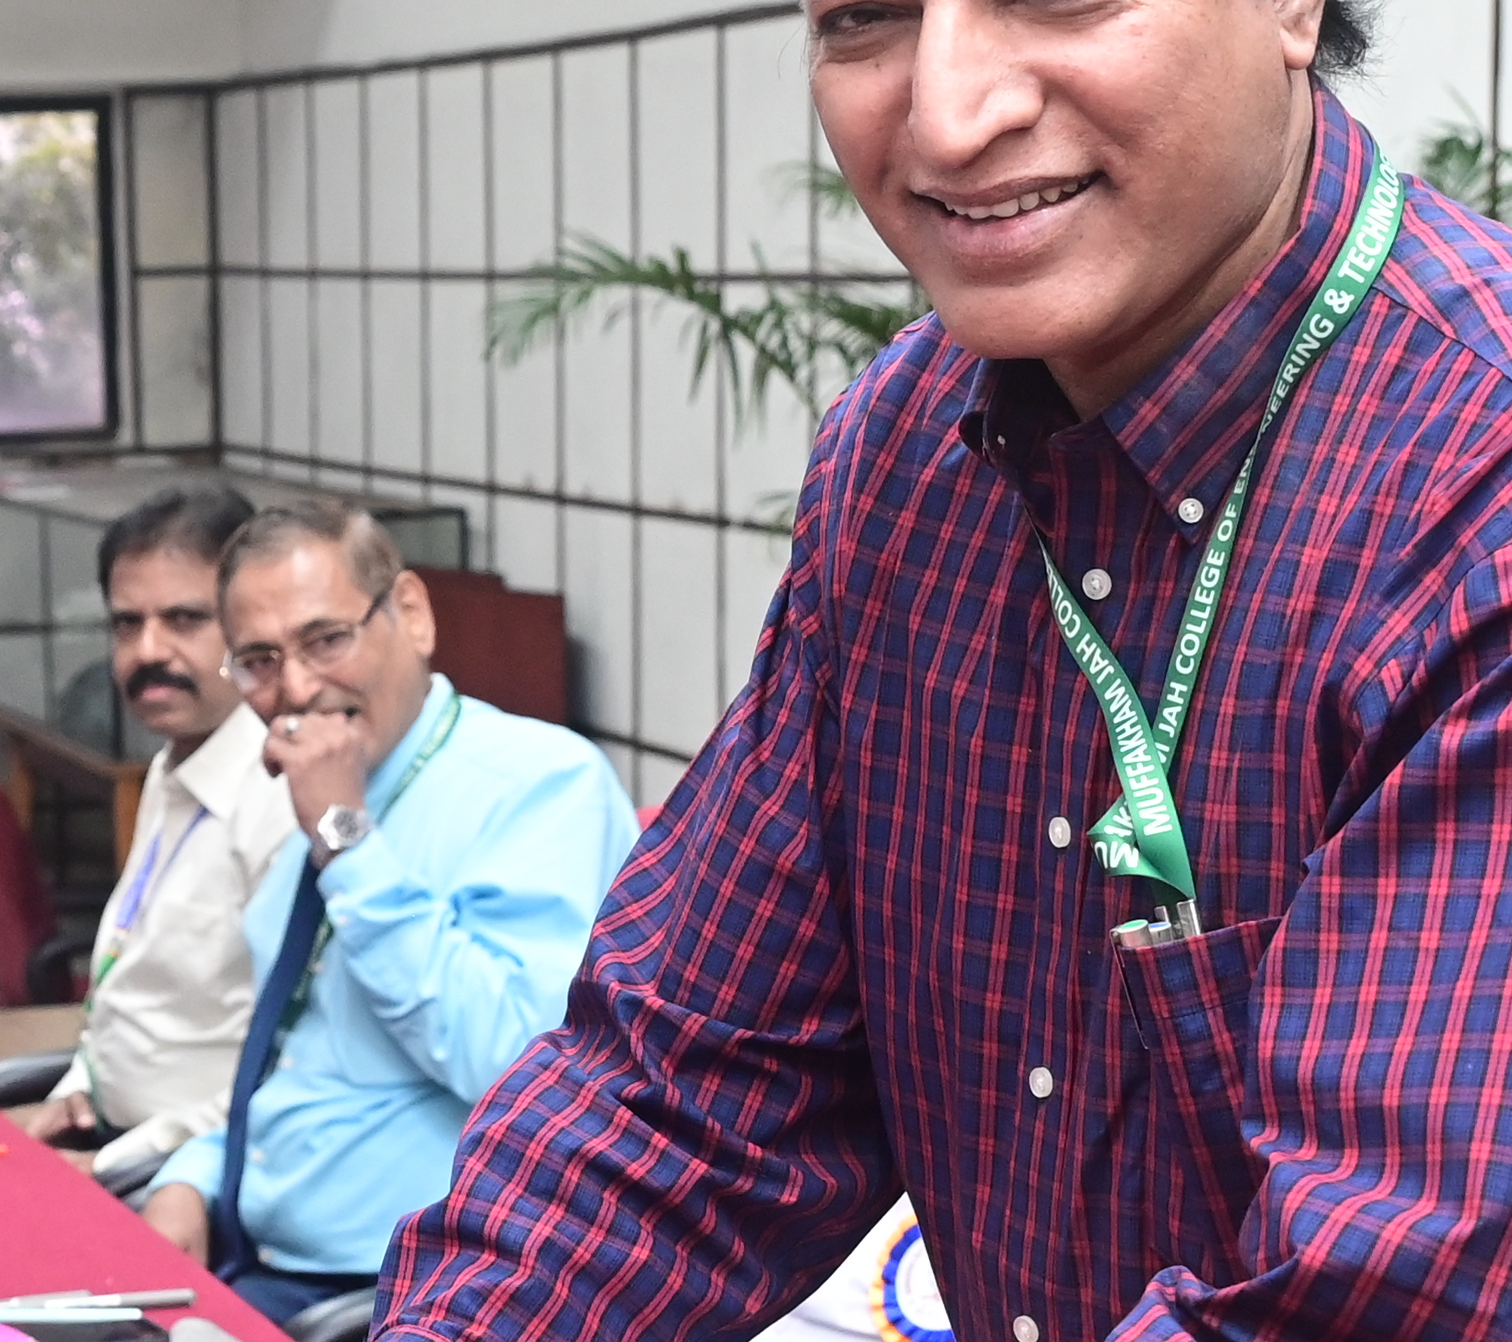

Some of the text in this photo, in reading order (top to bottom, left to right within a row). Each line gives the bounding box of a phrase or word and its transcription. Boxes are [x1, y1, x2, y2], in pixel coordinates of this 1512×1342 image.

[1337, 153, 1401, 285] TECHNOLO
[1323, 287, 1356, 316] &
[1217, 501, 1240, 543] OF
[1175, 548, 1226, 675] COLLEGE
[1075, 632, 1116, 685] JAH
[1157, 681, 1189, 740] JAH
[1103, 678, 1175, 837] MUFFAKHAM
